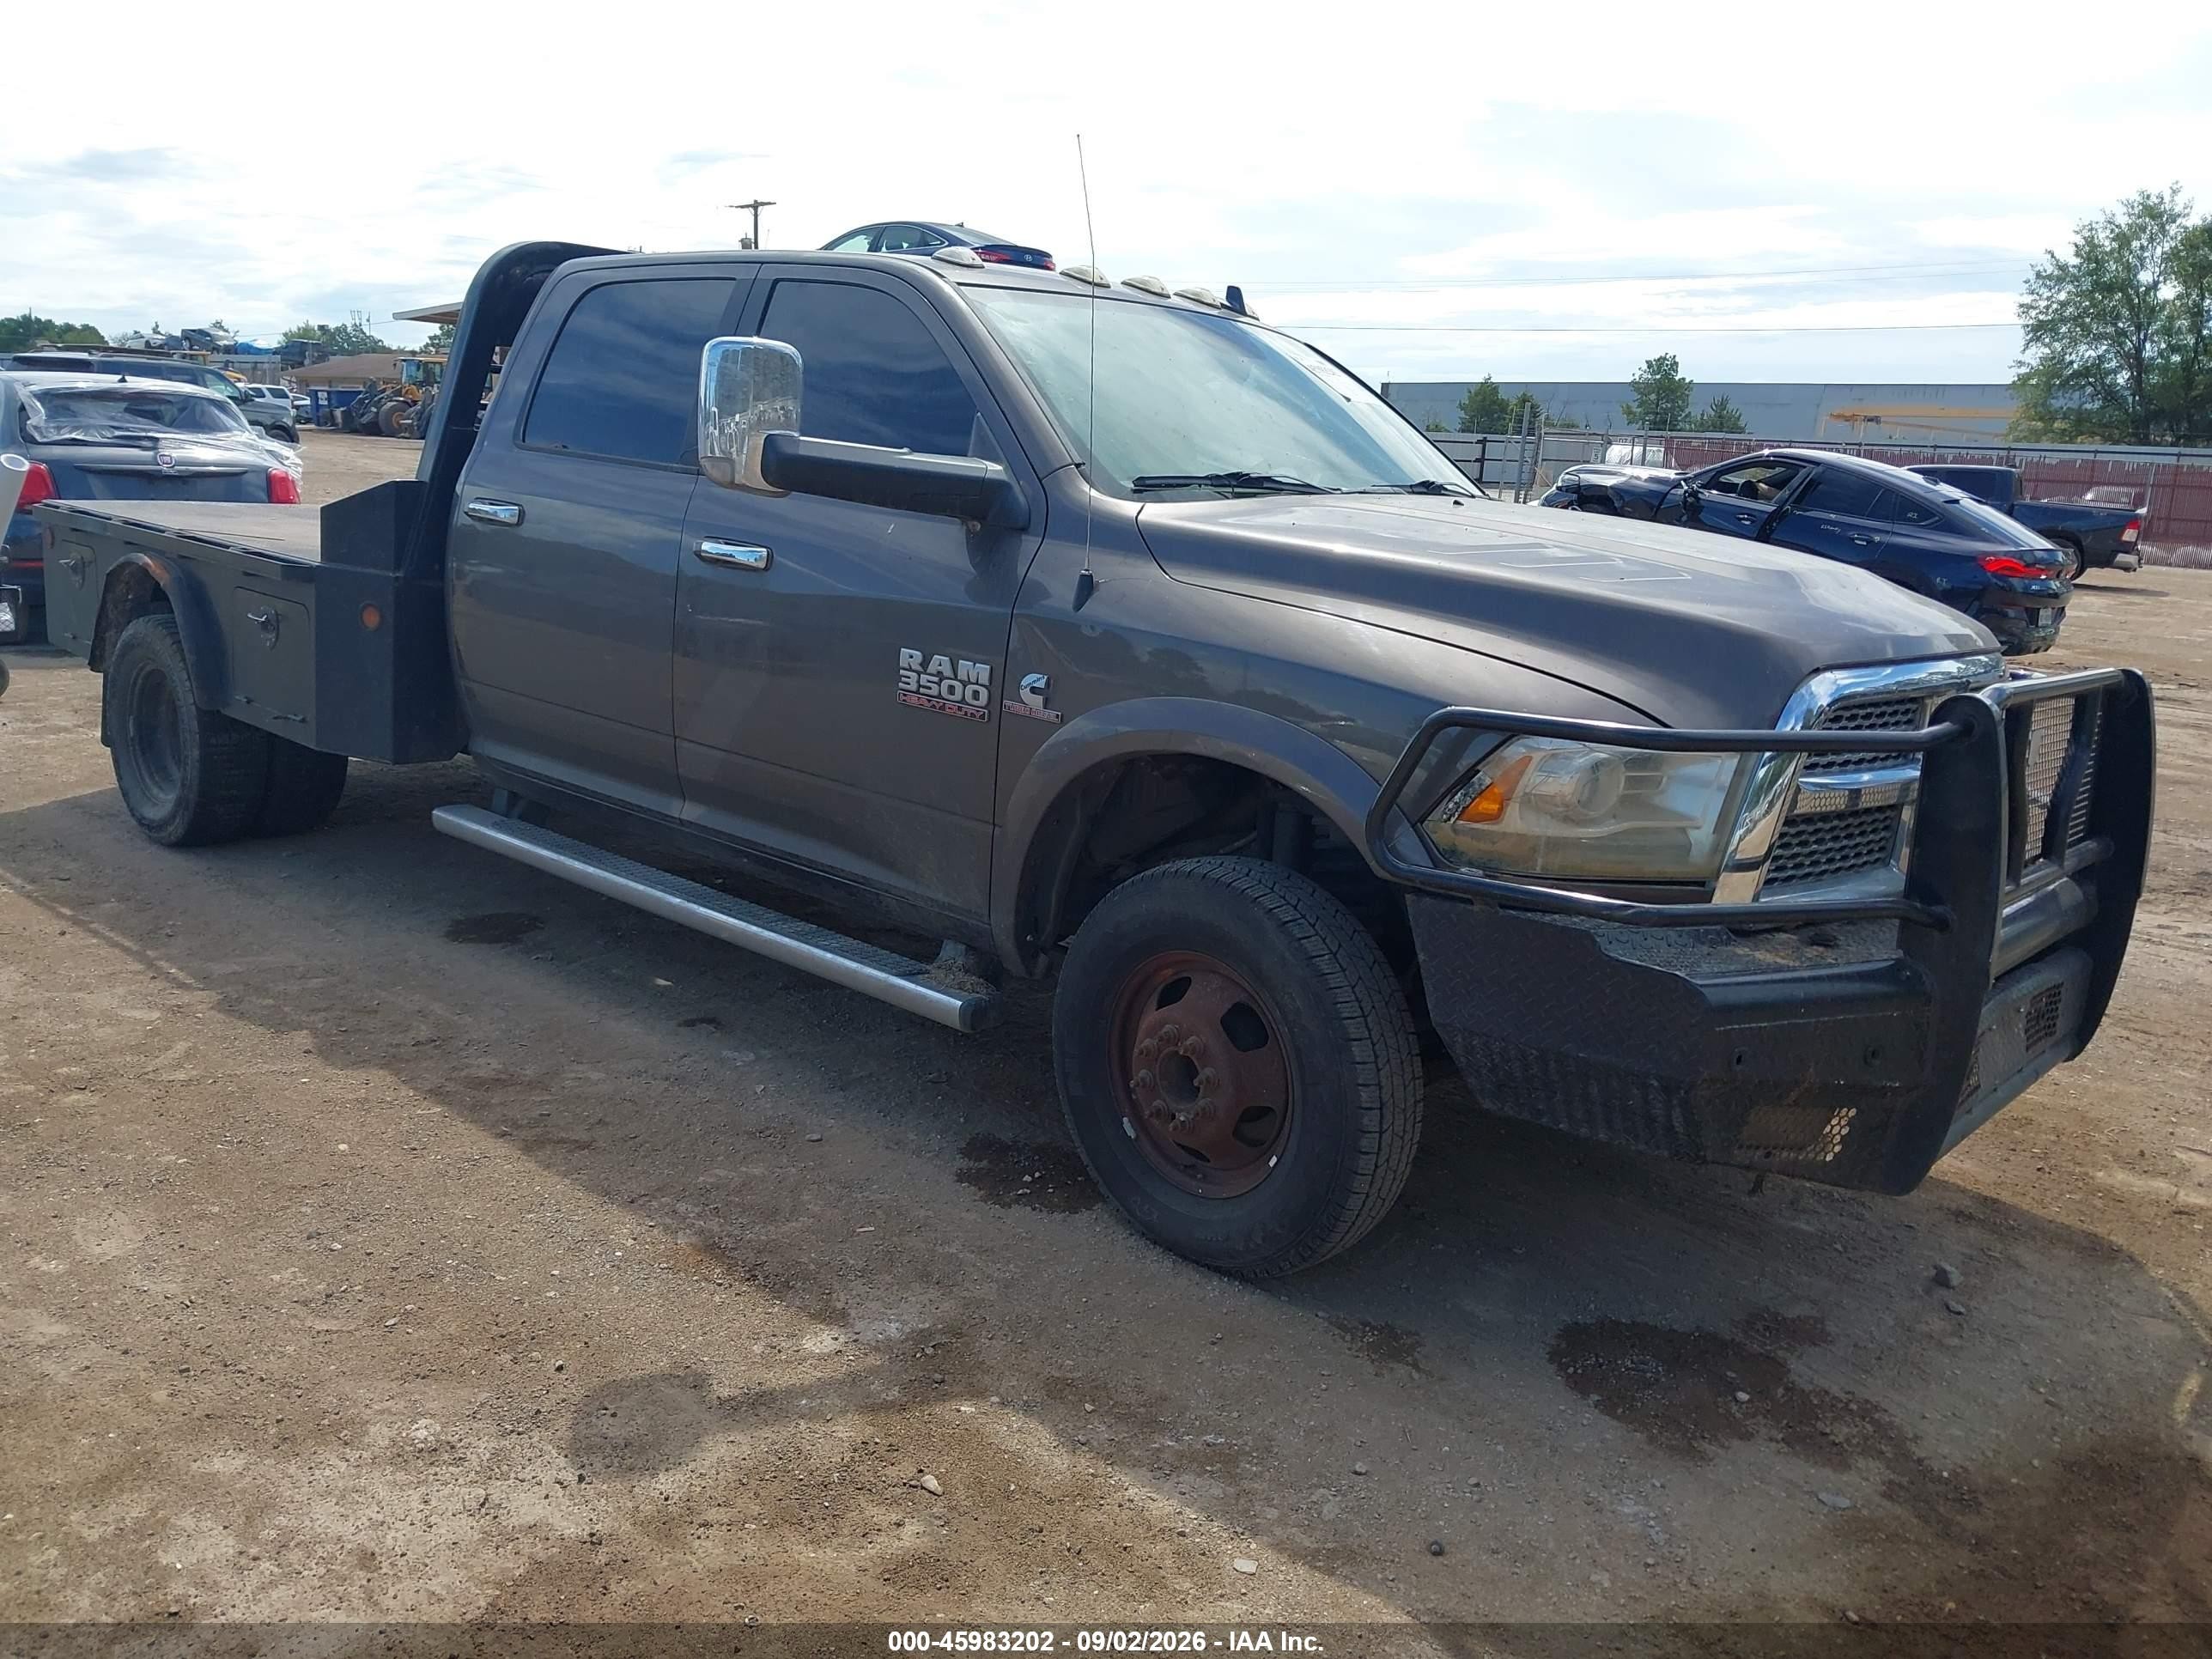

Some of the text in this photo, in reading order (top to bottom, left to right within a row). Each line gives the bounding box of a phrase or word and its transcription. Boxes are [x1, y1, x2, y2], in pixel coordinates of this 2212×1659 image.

[899, 647, 990, 686] RAM
[898, 669, 989, 708] 3500
[899, 693, 984, 719] HEAVY DUTY
